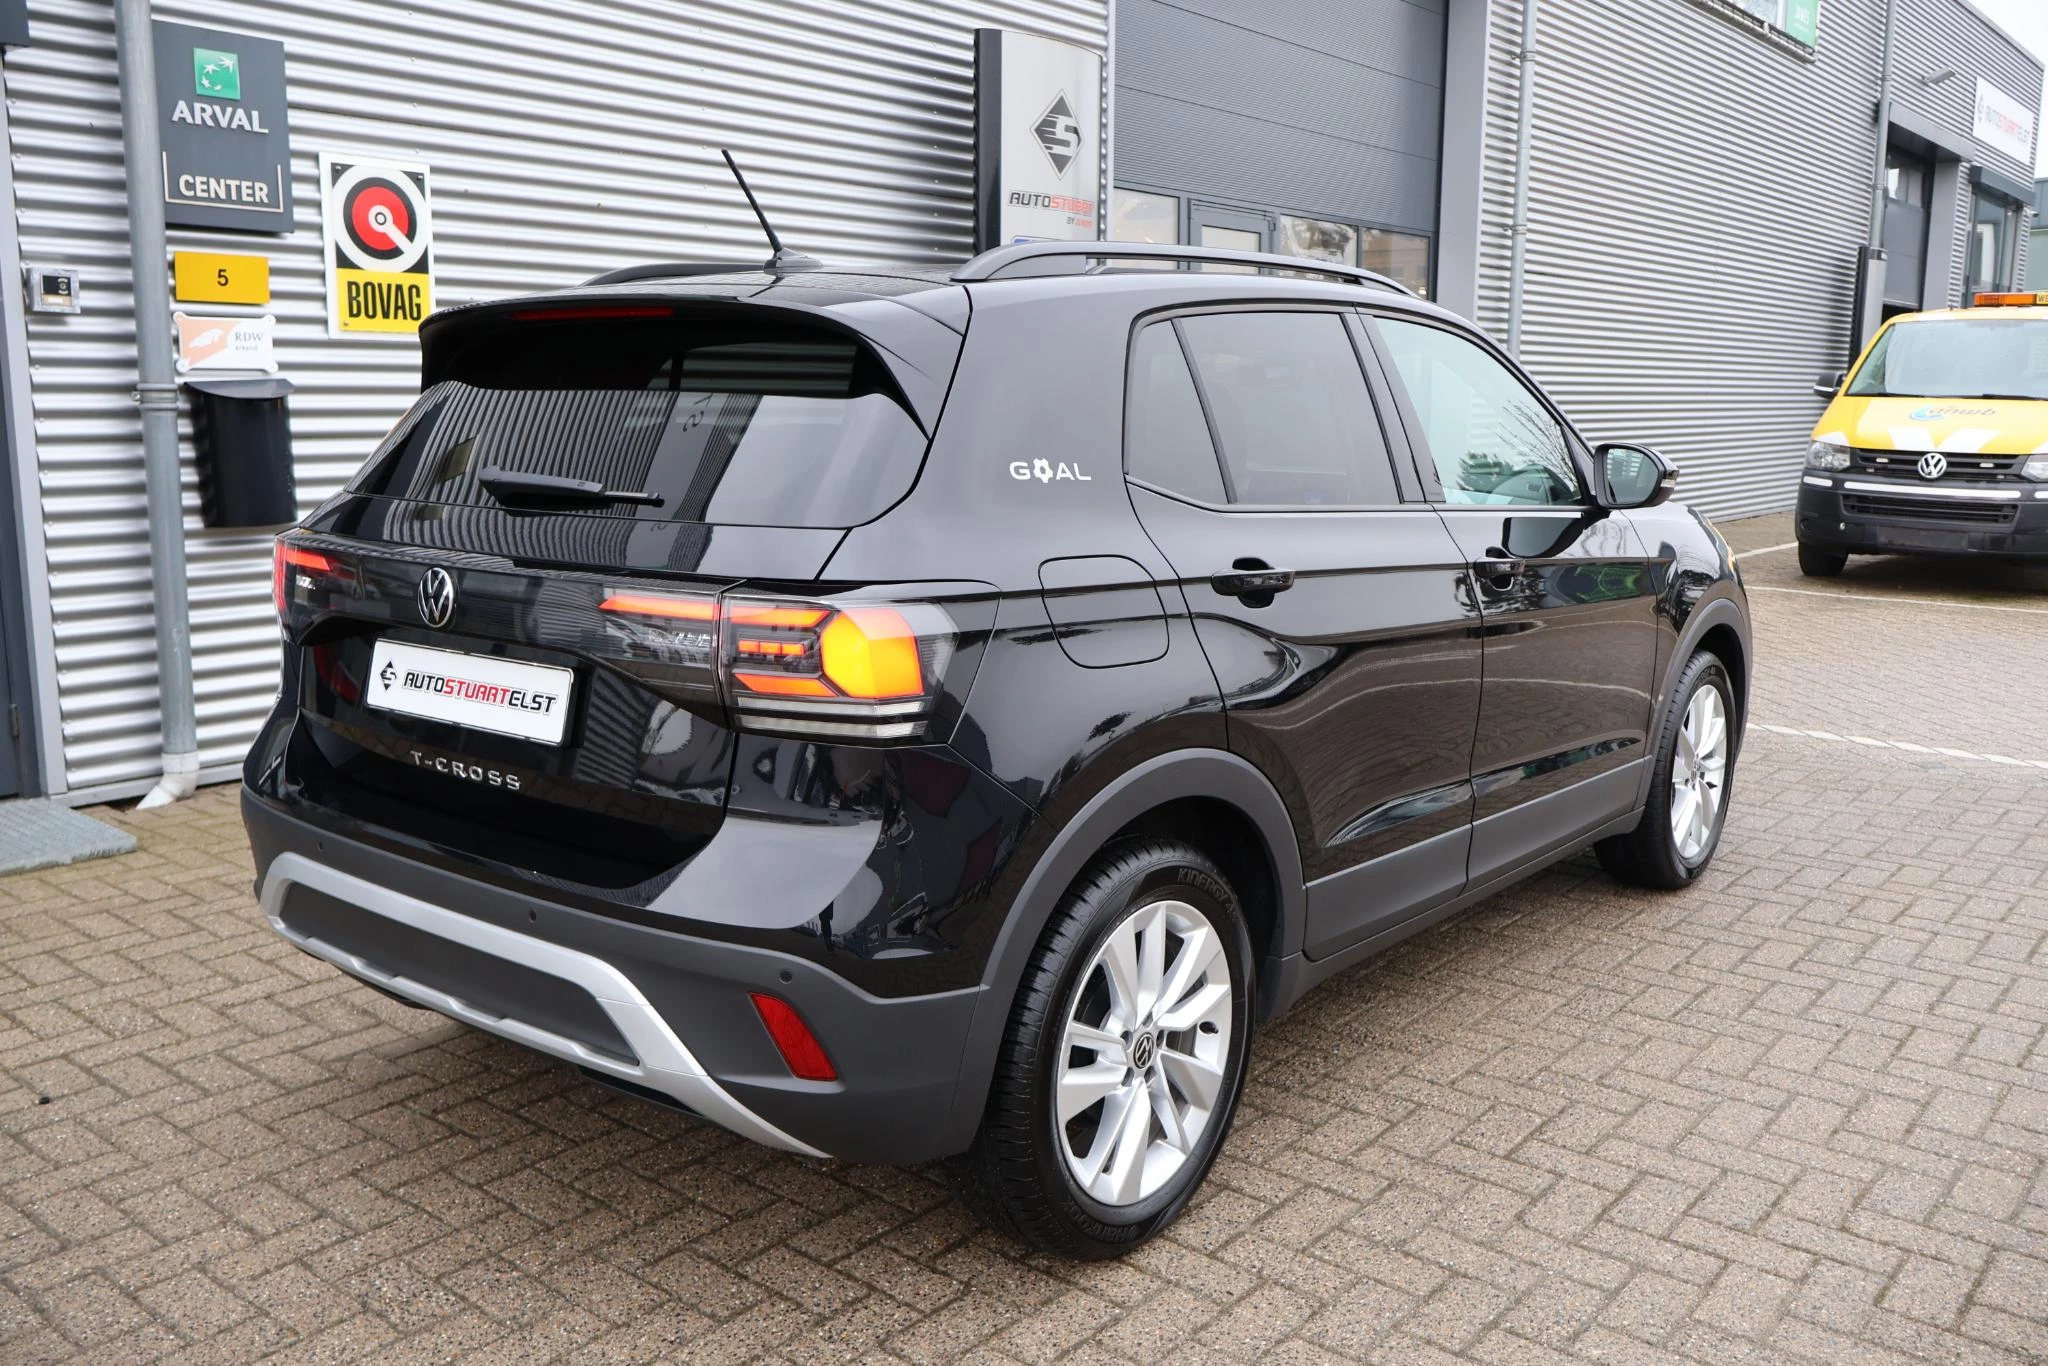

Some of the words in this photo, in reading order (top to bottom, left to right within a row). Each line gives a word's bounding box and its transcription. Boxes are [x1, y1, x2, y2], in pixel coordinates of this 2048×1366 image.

[171, 100, 269, 134] ARVAL
[179, 174, 269, 204] CENTER
[217, 269, 229, 287] 5
[347, 280, 422, 321] BOVAG
[234, 331, 264, 342] RDW
[403, 671, 557, 714] AUTOSTUARTELST
[410, 750, 521, 791] T-CROSS
[1177, 868, 1229, 902] KINERGY
